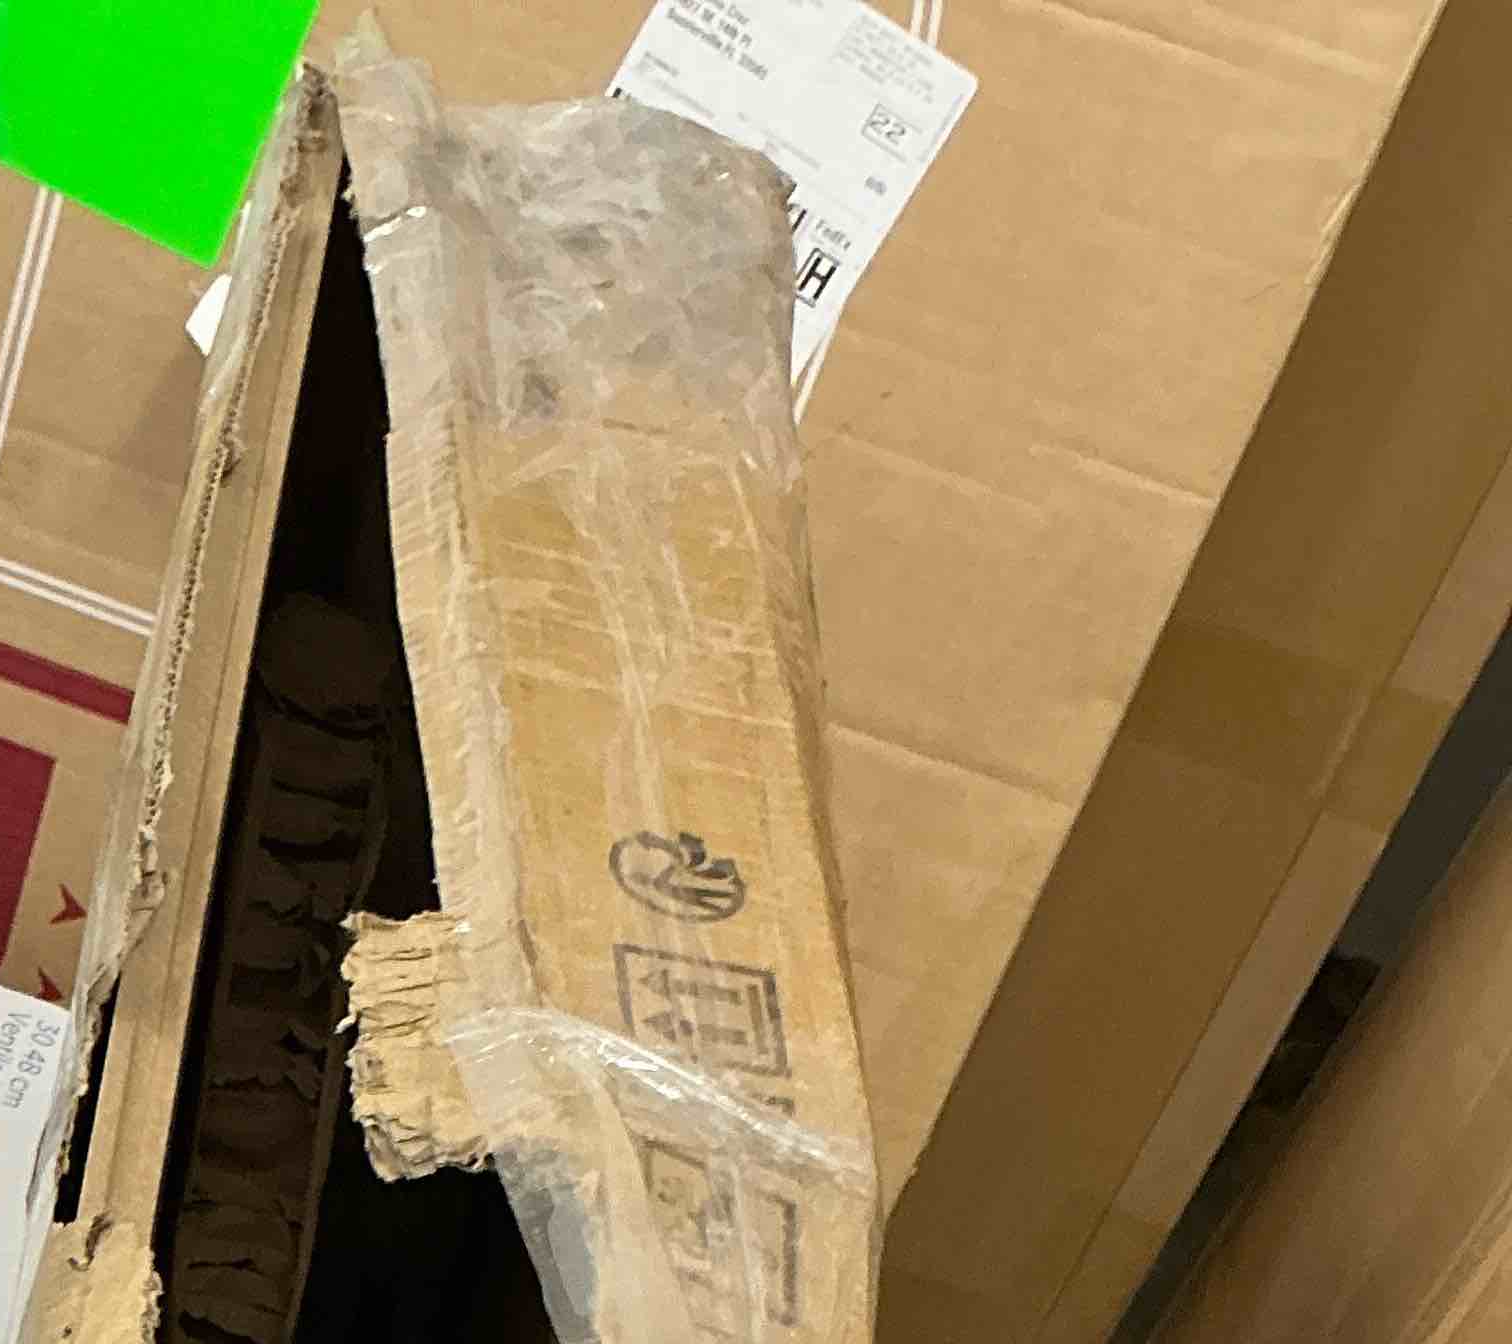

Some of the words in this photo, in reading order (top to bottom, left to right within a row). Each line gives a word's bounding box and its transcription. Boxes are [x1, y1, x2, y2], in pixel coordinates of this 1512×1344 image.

[868, 111, 907, 146] 22
[798, 256, 839, 301] H
[2, 1077, 29, 1109] cm
